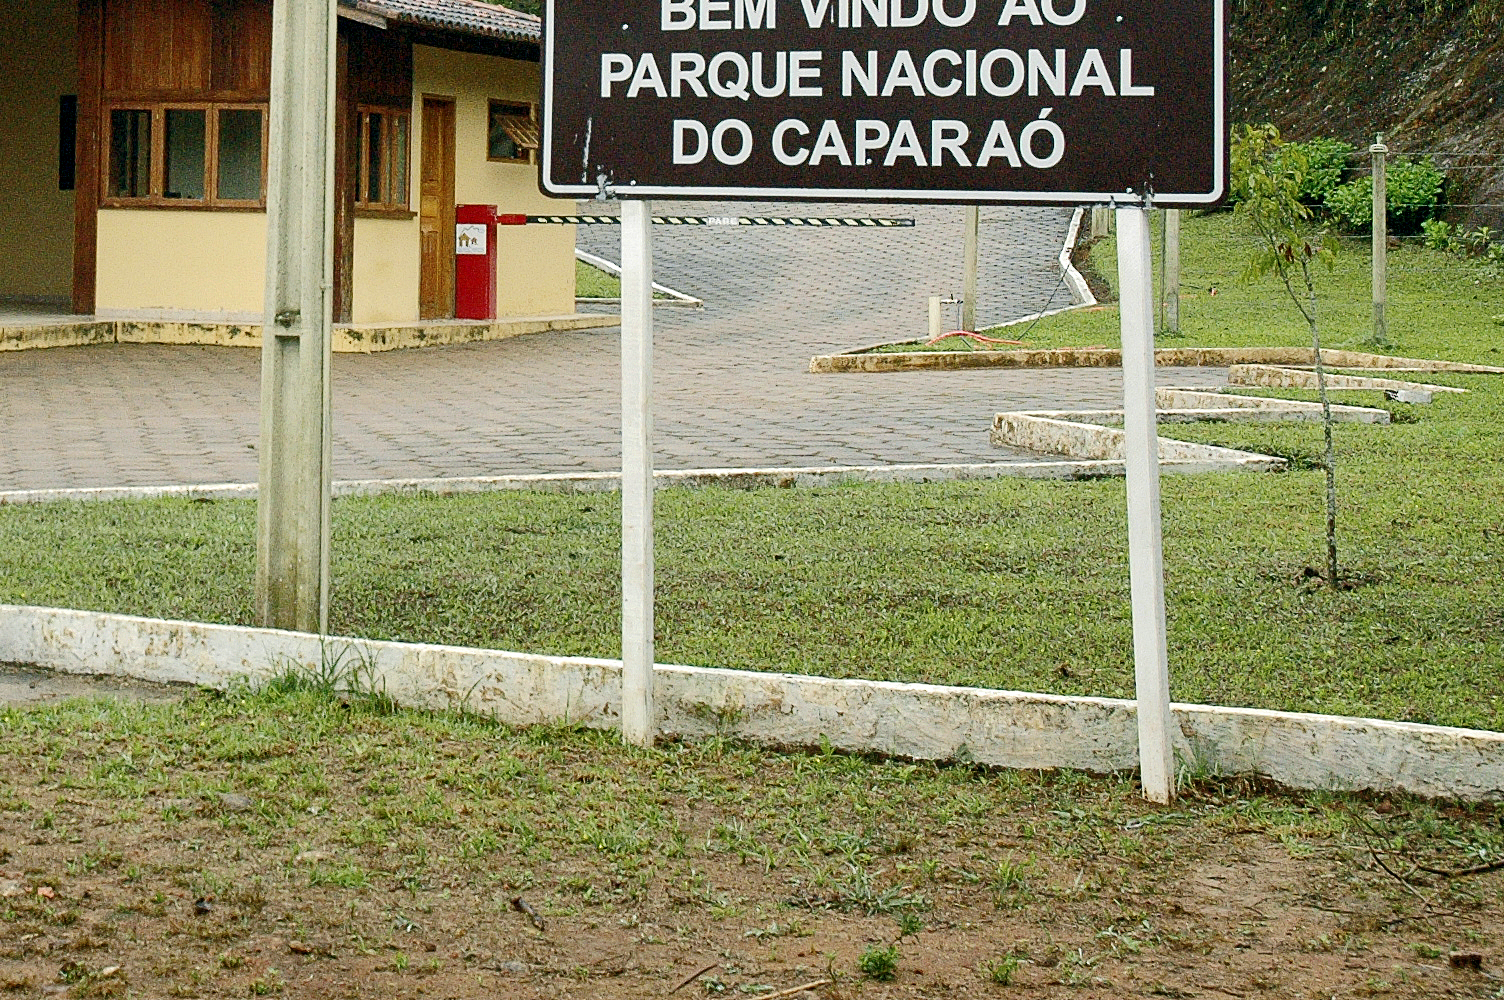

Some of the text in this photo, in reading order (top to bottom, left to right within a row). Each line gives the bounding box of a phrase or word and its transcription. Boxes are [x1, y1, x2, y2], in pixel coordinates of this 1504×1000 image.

[600, 48, 1155, 102] PARQUE NACIONAL
[672, 107, 1066, 169] DO CAPARAÓ
